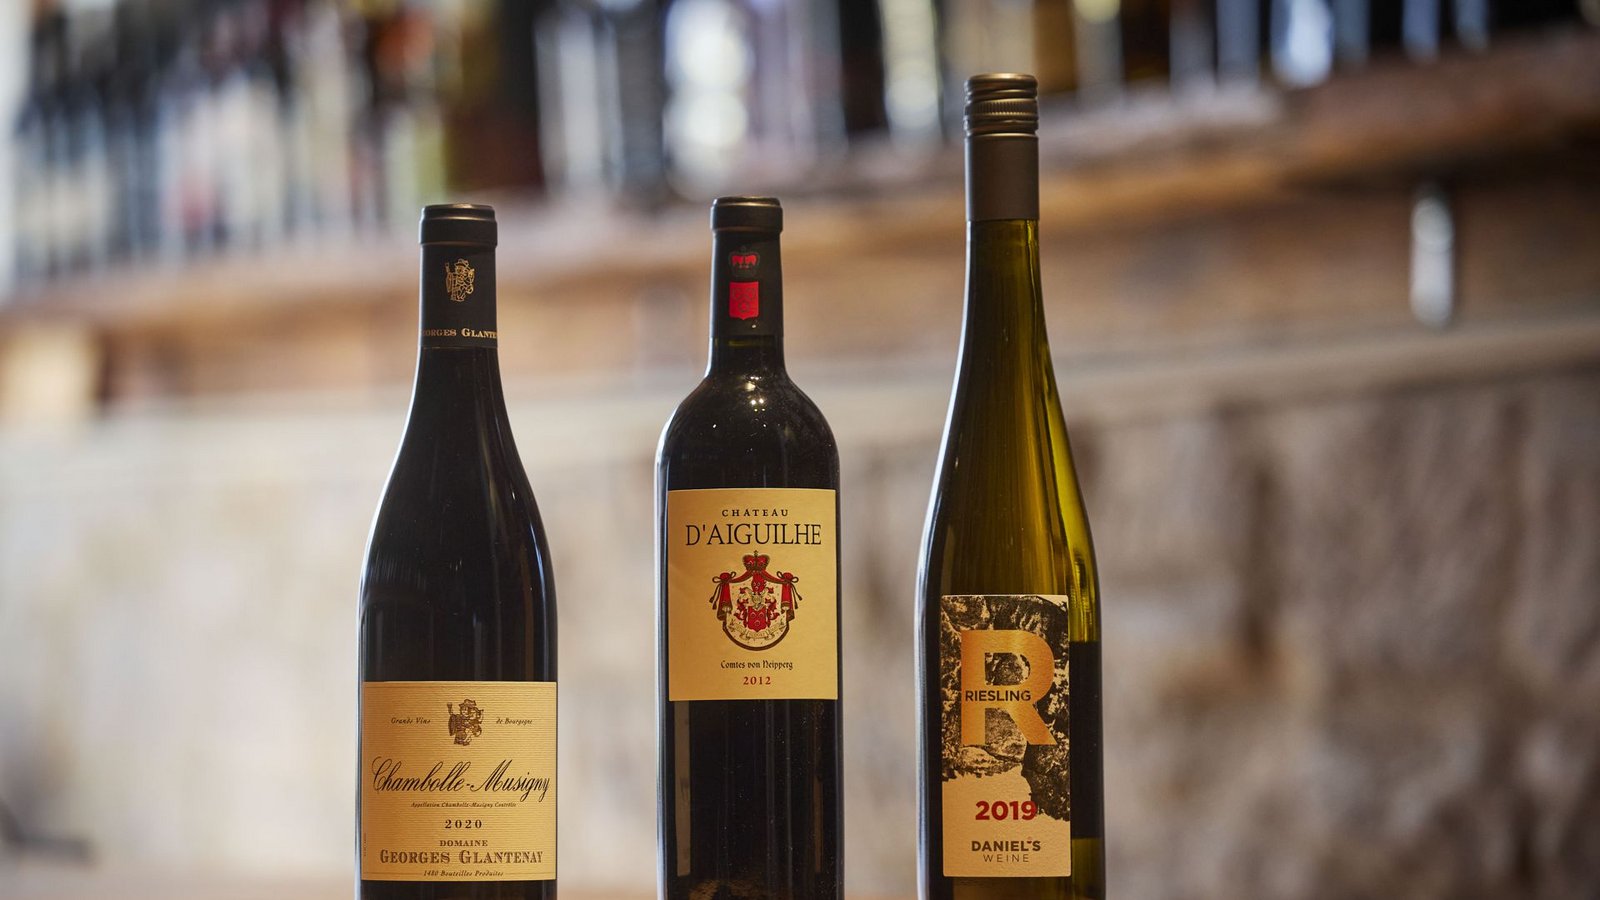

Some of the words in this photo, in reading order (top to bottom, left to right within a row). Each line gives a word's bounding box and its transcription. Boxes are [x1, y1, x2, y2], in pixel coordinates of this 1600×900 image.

[685, 523, 822, 546] D'AIGUILHE
[720, 660, 746, 669] Comtes
[747, 661, 761, 669] von
[762, 660, 793, 670] Neipperg
[743, 676, 771, 685] 2012
[961, 629, 1057, 745] R
[965, 690, 1031, 702] RIESLING
[371, 756, 551, 802] Chambolle-Musigny
[975, 801, 1037, 820] 2019
[445, 819, 483, 829] 2020
[380, 850, 451, 864] GEORGES
[458, 849, 544, 864] GLANTENAY
[983, 854, 1030, 863] WEINE
